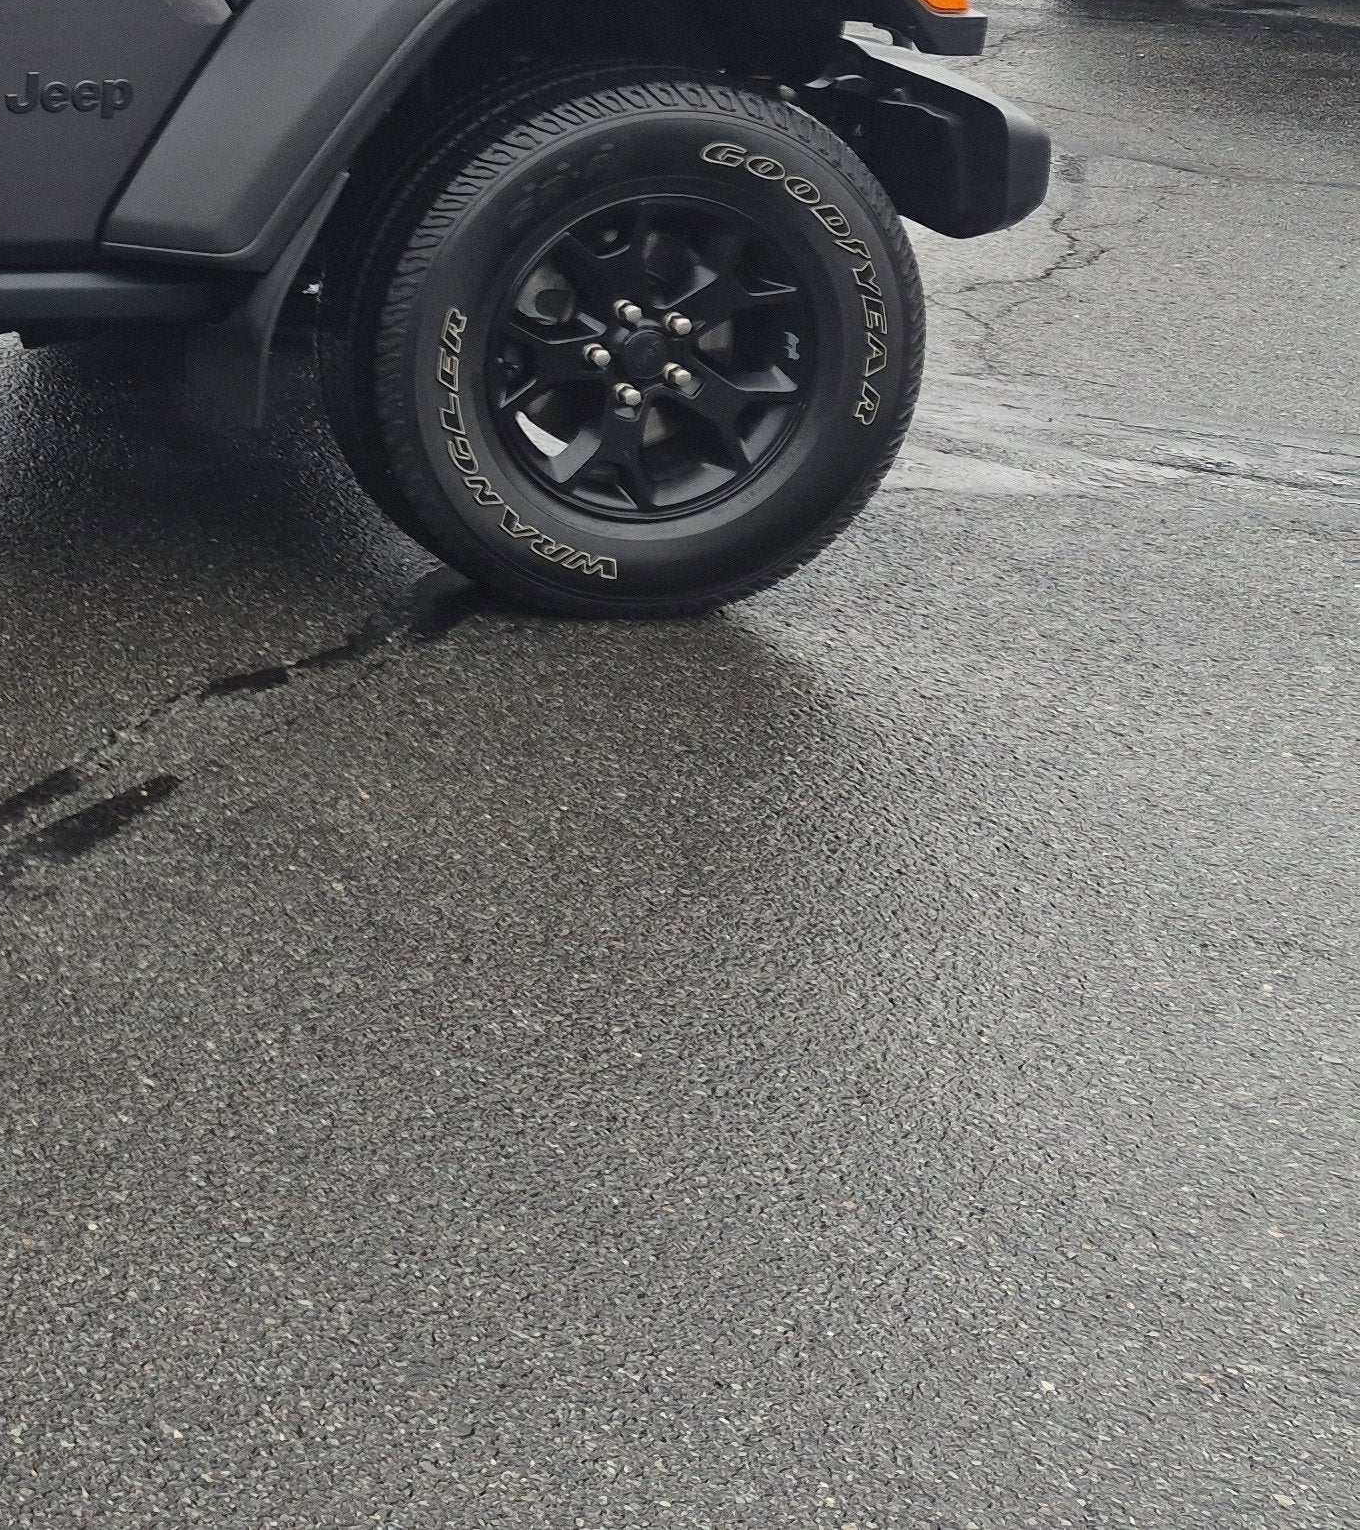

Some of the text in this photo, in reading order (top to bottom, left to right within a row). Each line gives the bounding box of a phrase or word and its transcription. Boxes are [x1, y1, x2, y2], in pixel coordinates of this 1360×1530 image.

[5, 71, 134, 120] Jeep
[701, 141, 889, 427] GOODYEAR
[434, 307, 618, 580] WRANGLER
